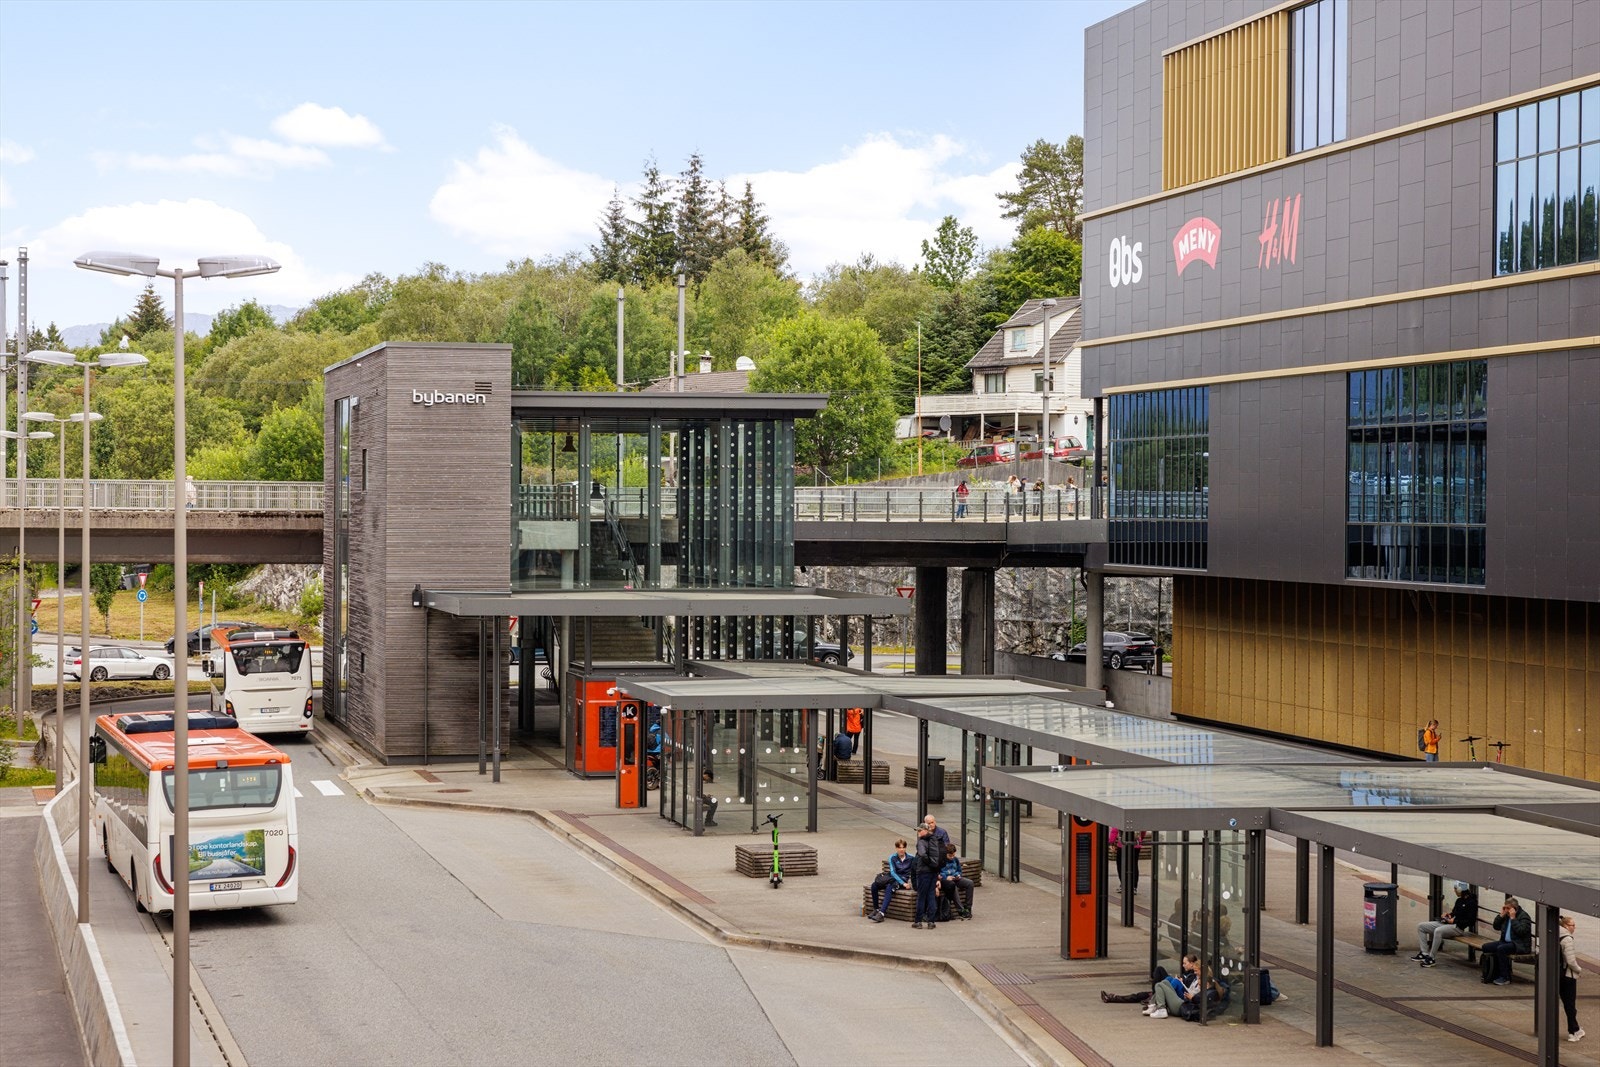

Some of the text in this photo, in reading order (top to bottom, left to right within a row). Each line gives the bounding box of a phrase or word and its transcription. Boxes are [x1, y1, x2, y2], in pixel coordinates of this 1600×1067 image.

[1178, 227, 1216, 261] MENY
[1258, 193, 1302, 270] H&M
[1109, 235, 1143, 288] Obs
[412, 389, 486, 406] bybanen
[626, 706, 634, 716] K
[264, 829, 283, 837] 7020
